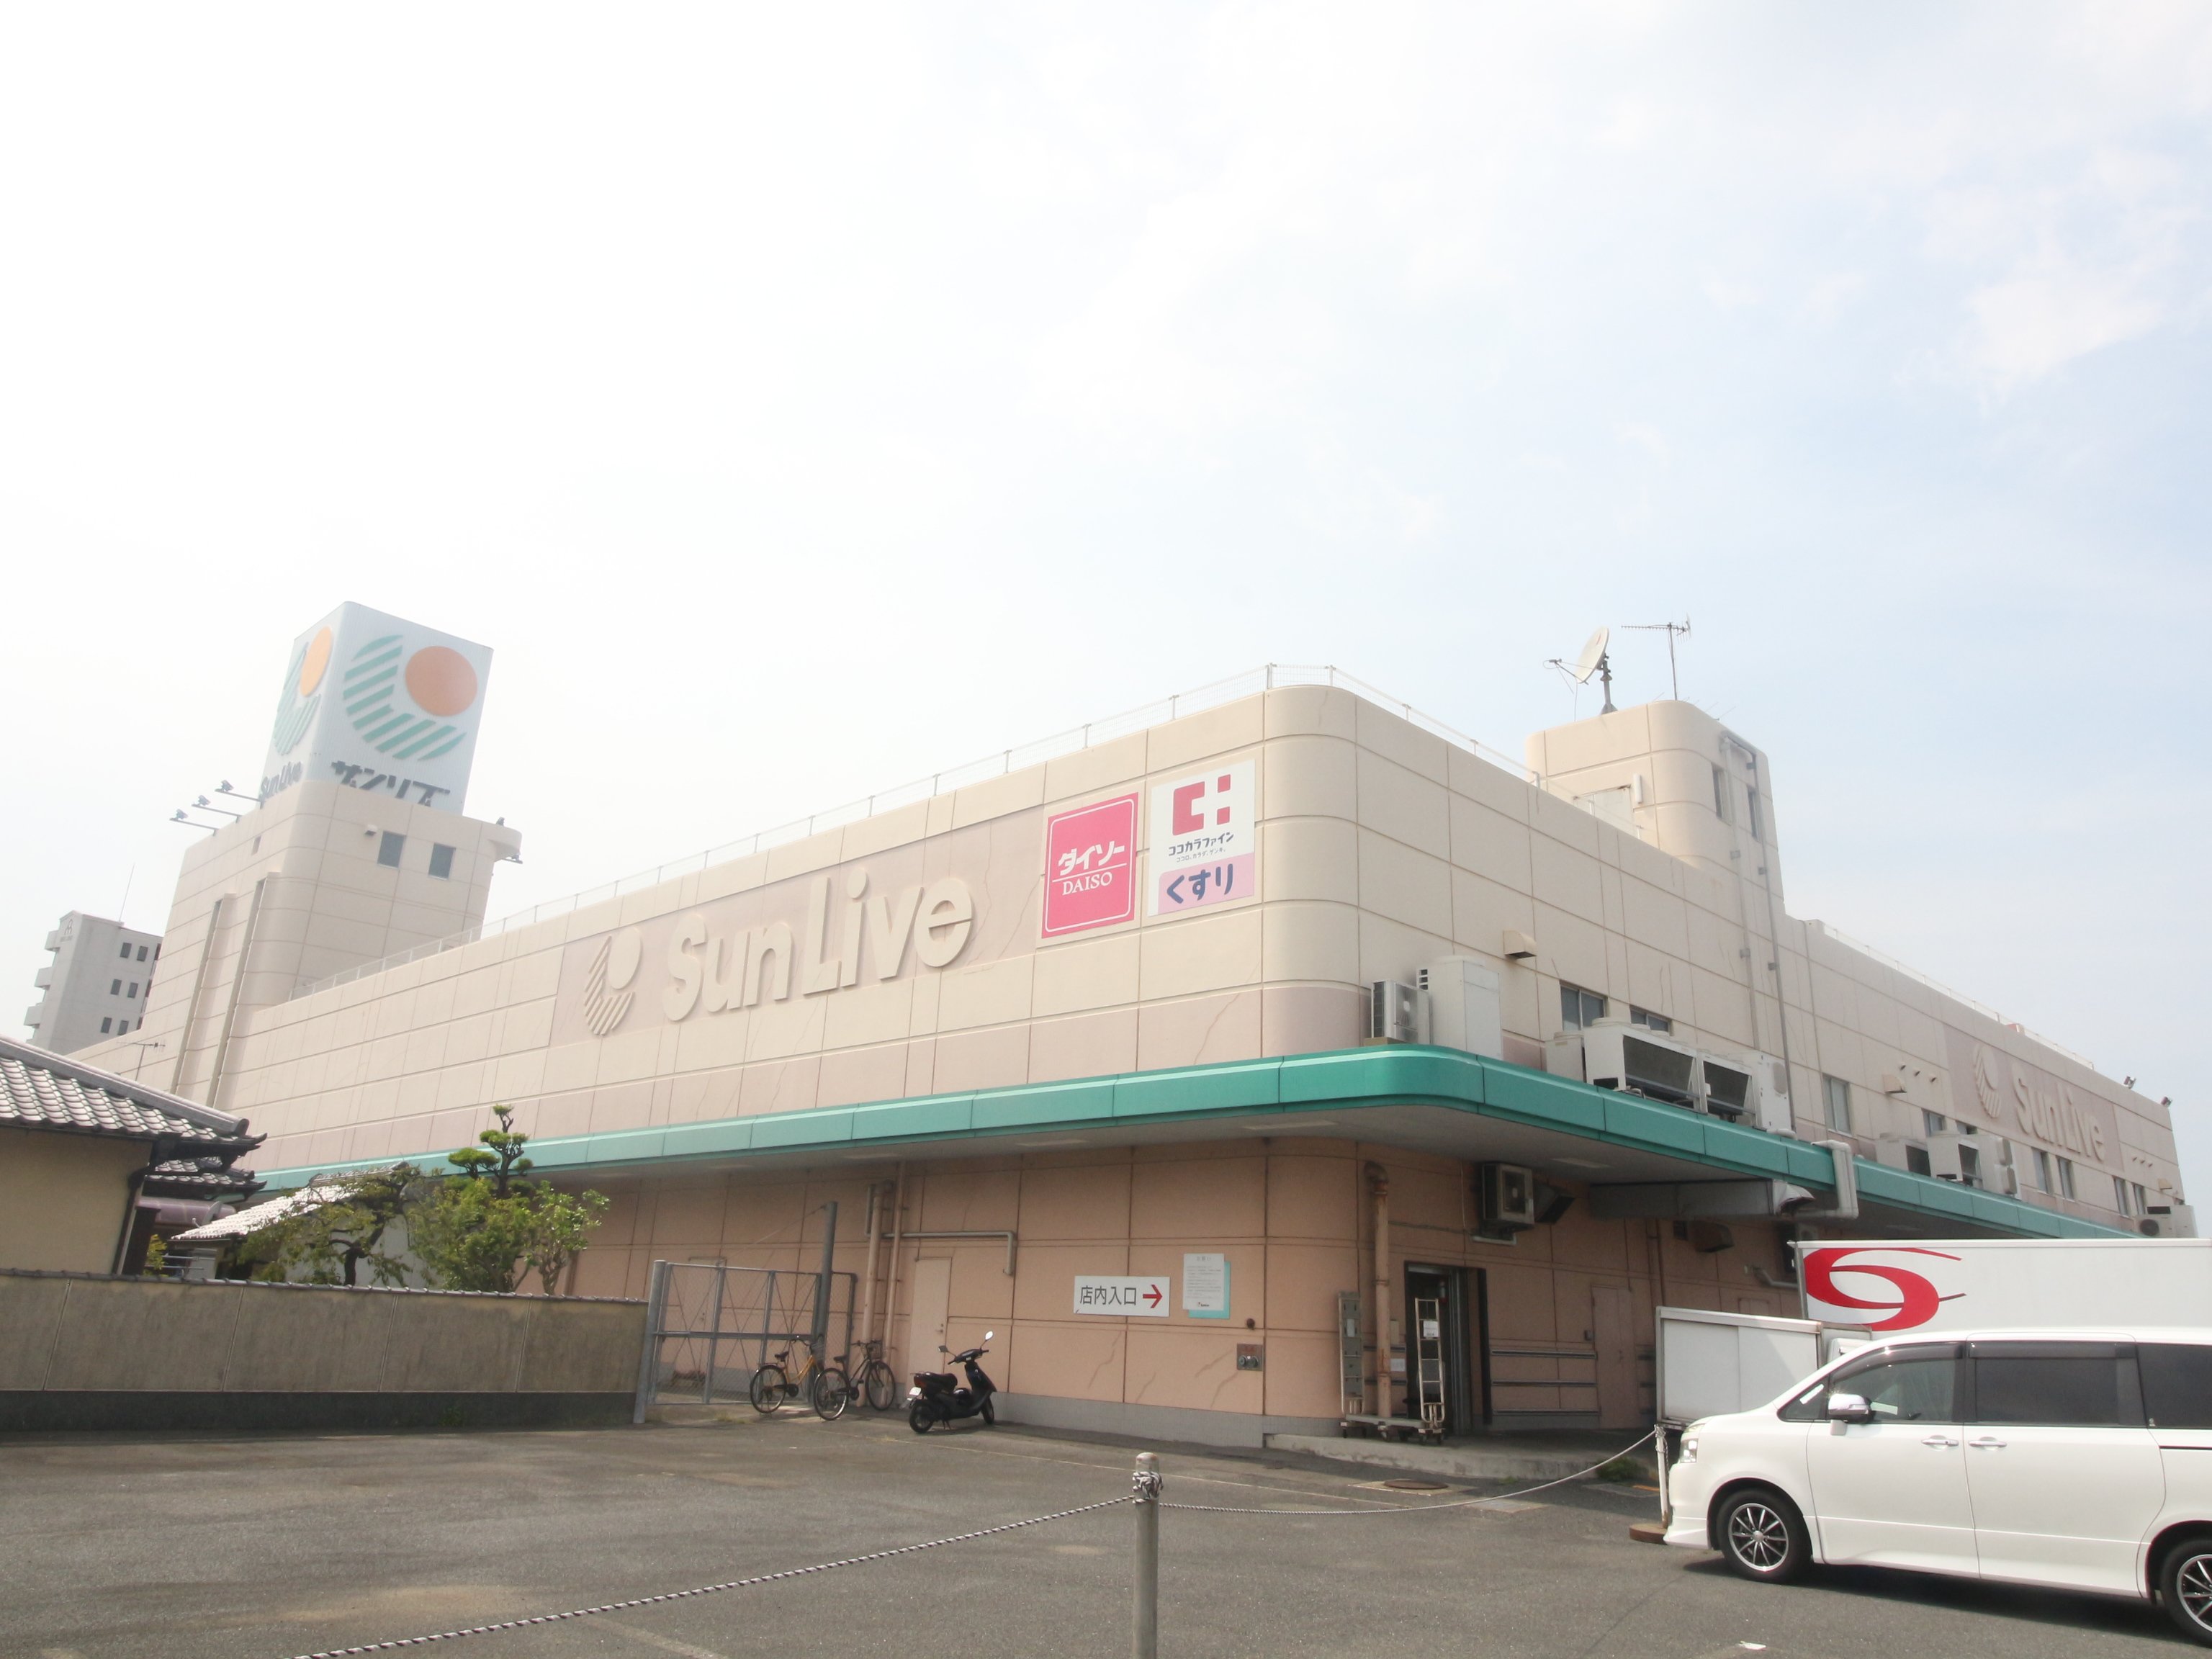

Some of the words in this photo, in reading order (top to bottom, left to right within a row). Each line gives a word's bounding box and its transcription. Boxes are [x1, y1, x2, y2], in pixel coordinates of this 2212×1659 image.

[1058, 840, 1125, 876] ダイソー
[1168, 832, 1234, 856] ココカラファイン
[1062, 871, 1112, 896] DAISO
[1166, 863, 1233, 904] くすり
[662, 868, 974, 1022] SunLive
[2011, 1061, 2105, 1164] SunLive
[1079, 1285, 1137, 1305] 店内入口
